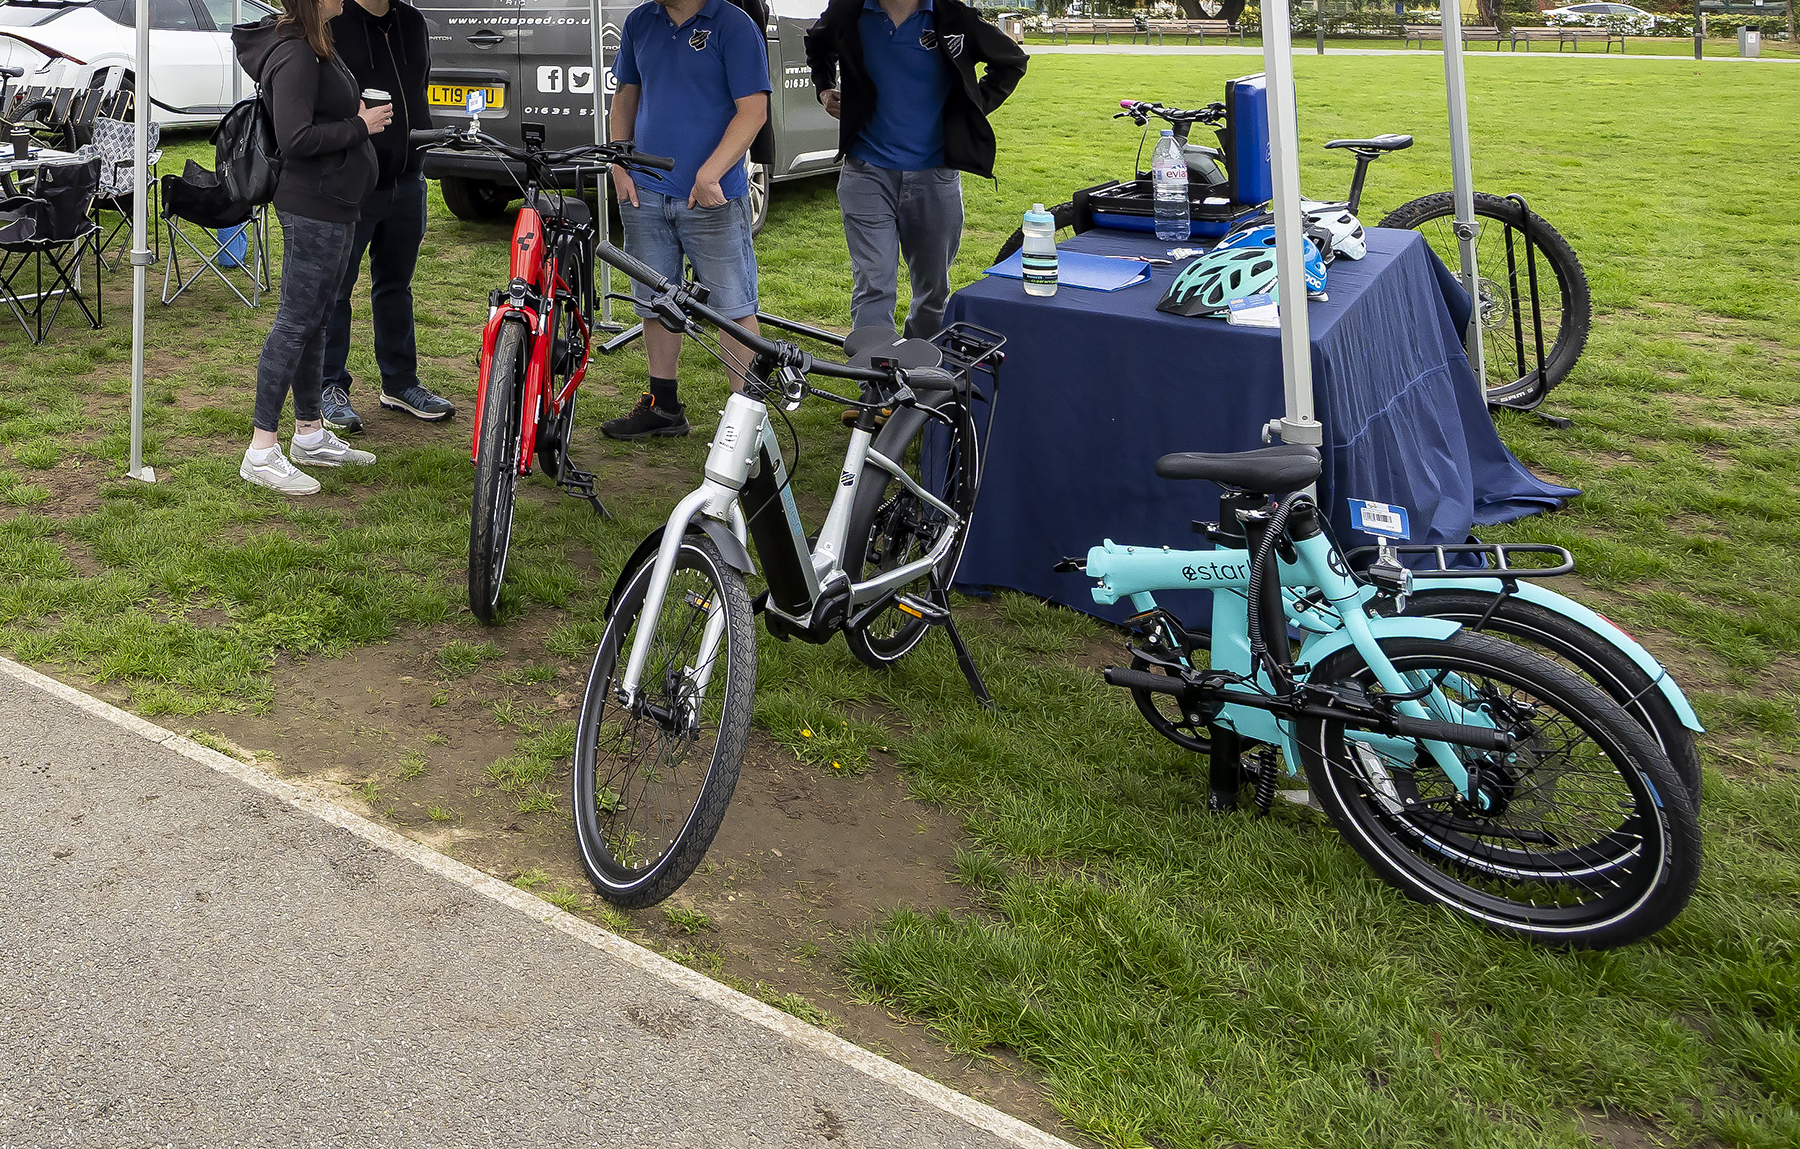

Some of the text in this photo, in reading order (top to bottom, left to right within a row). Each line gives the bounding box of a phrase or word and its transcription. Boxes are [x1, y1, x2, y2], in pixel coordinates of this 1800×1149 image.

[448, 15, 591, 26] www.velospeed.co.u
[784, 78, 809, 89] 01635
[432, 87, 463, 103] LT19
[524, 107, 571, 115] 01635
[1166, 169, 1187, 179] evia
